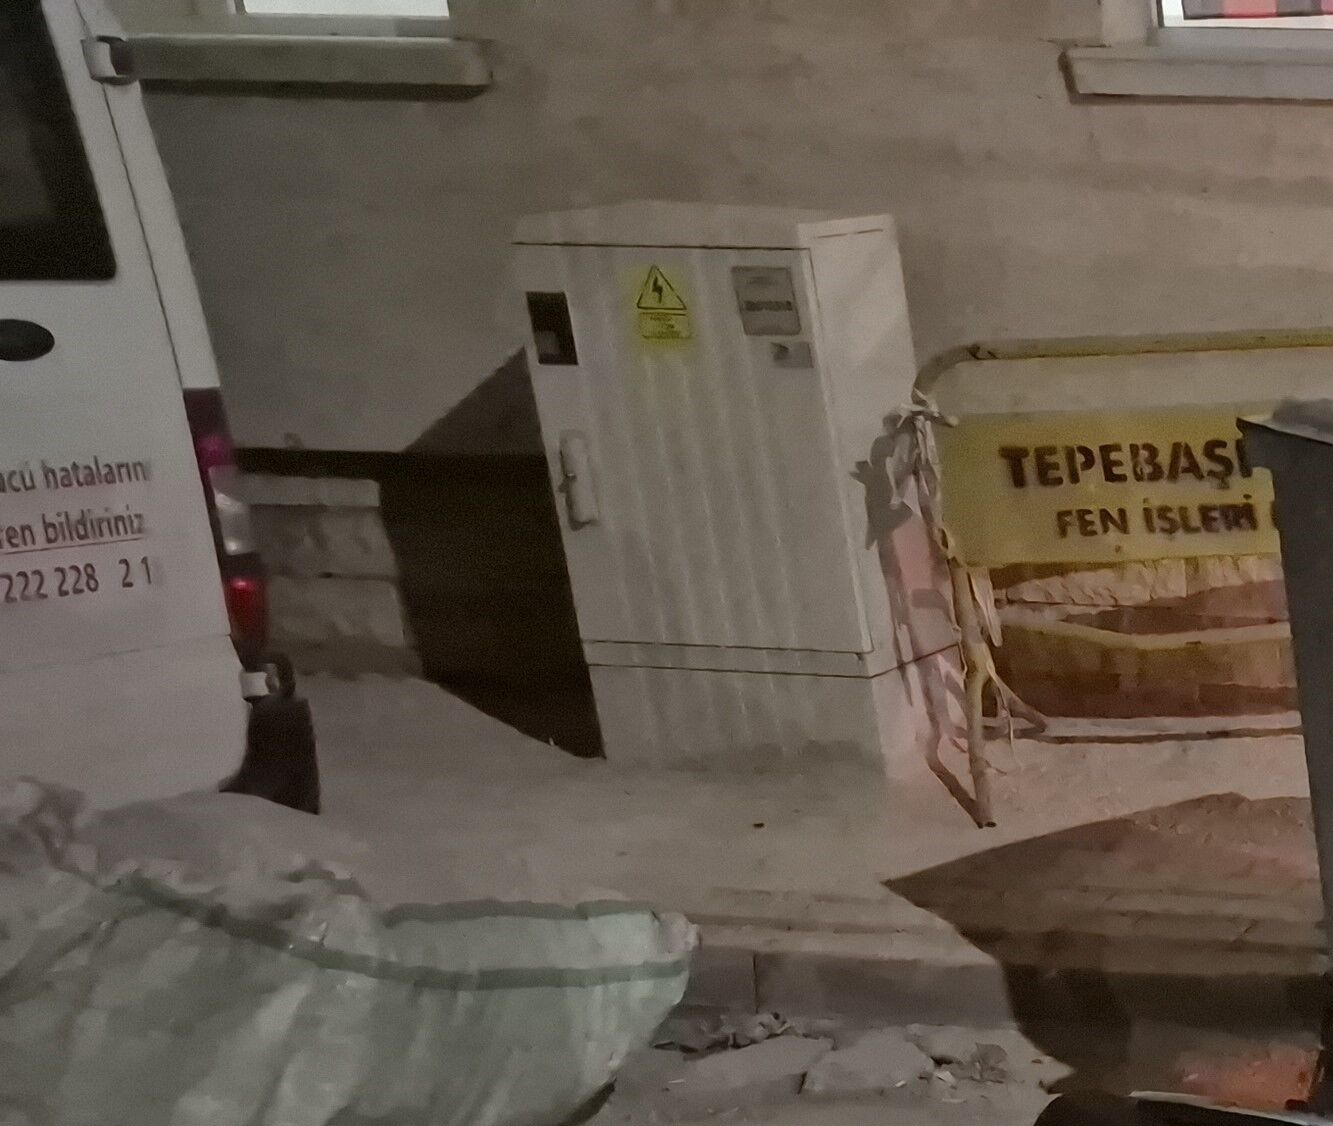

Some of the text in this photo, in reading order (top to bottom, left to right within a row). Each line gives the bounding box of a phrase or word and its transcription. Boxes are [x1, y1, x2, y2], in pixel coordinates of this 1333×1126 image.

[42, 503, 146, 545] bildiriniz
[1056, 506, 1130, 539] FEN
[54, 562, 99, 597] 228
